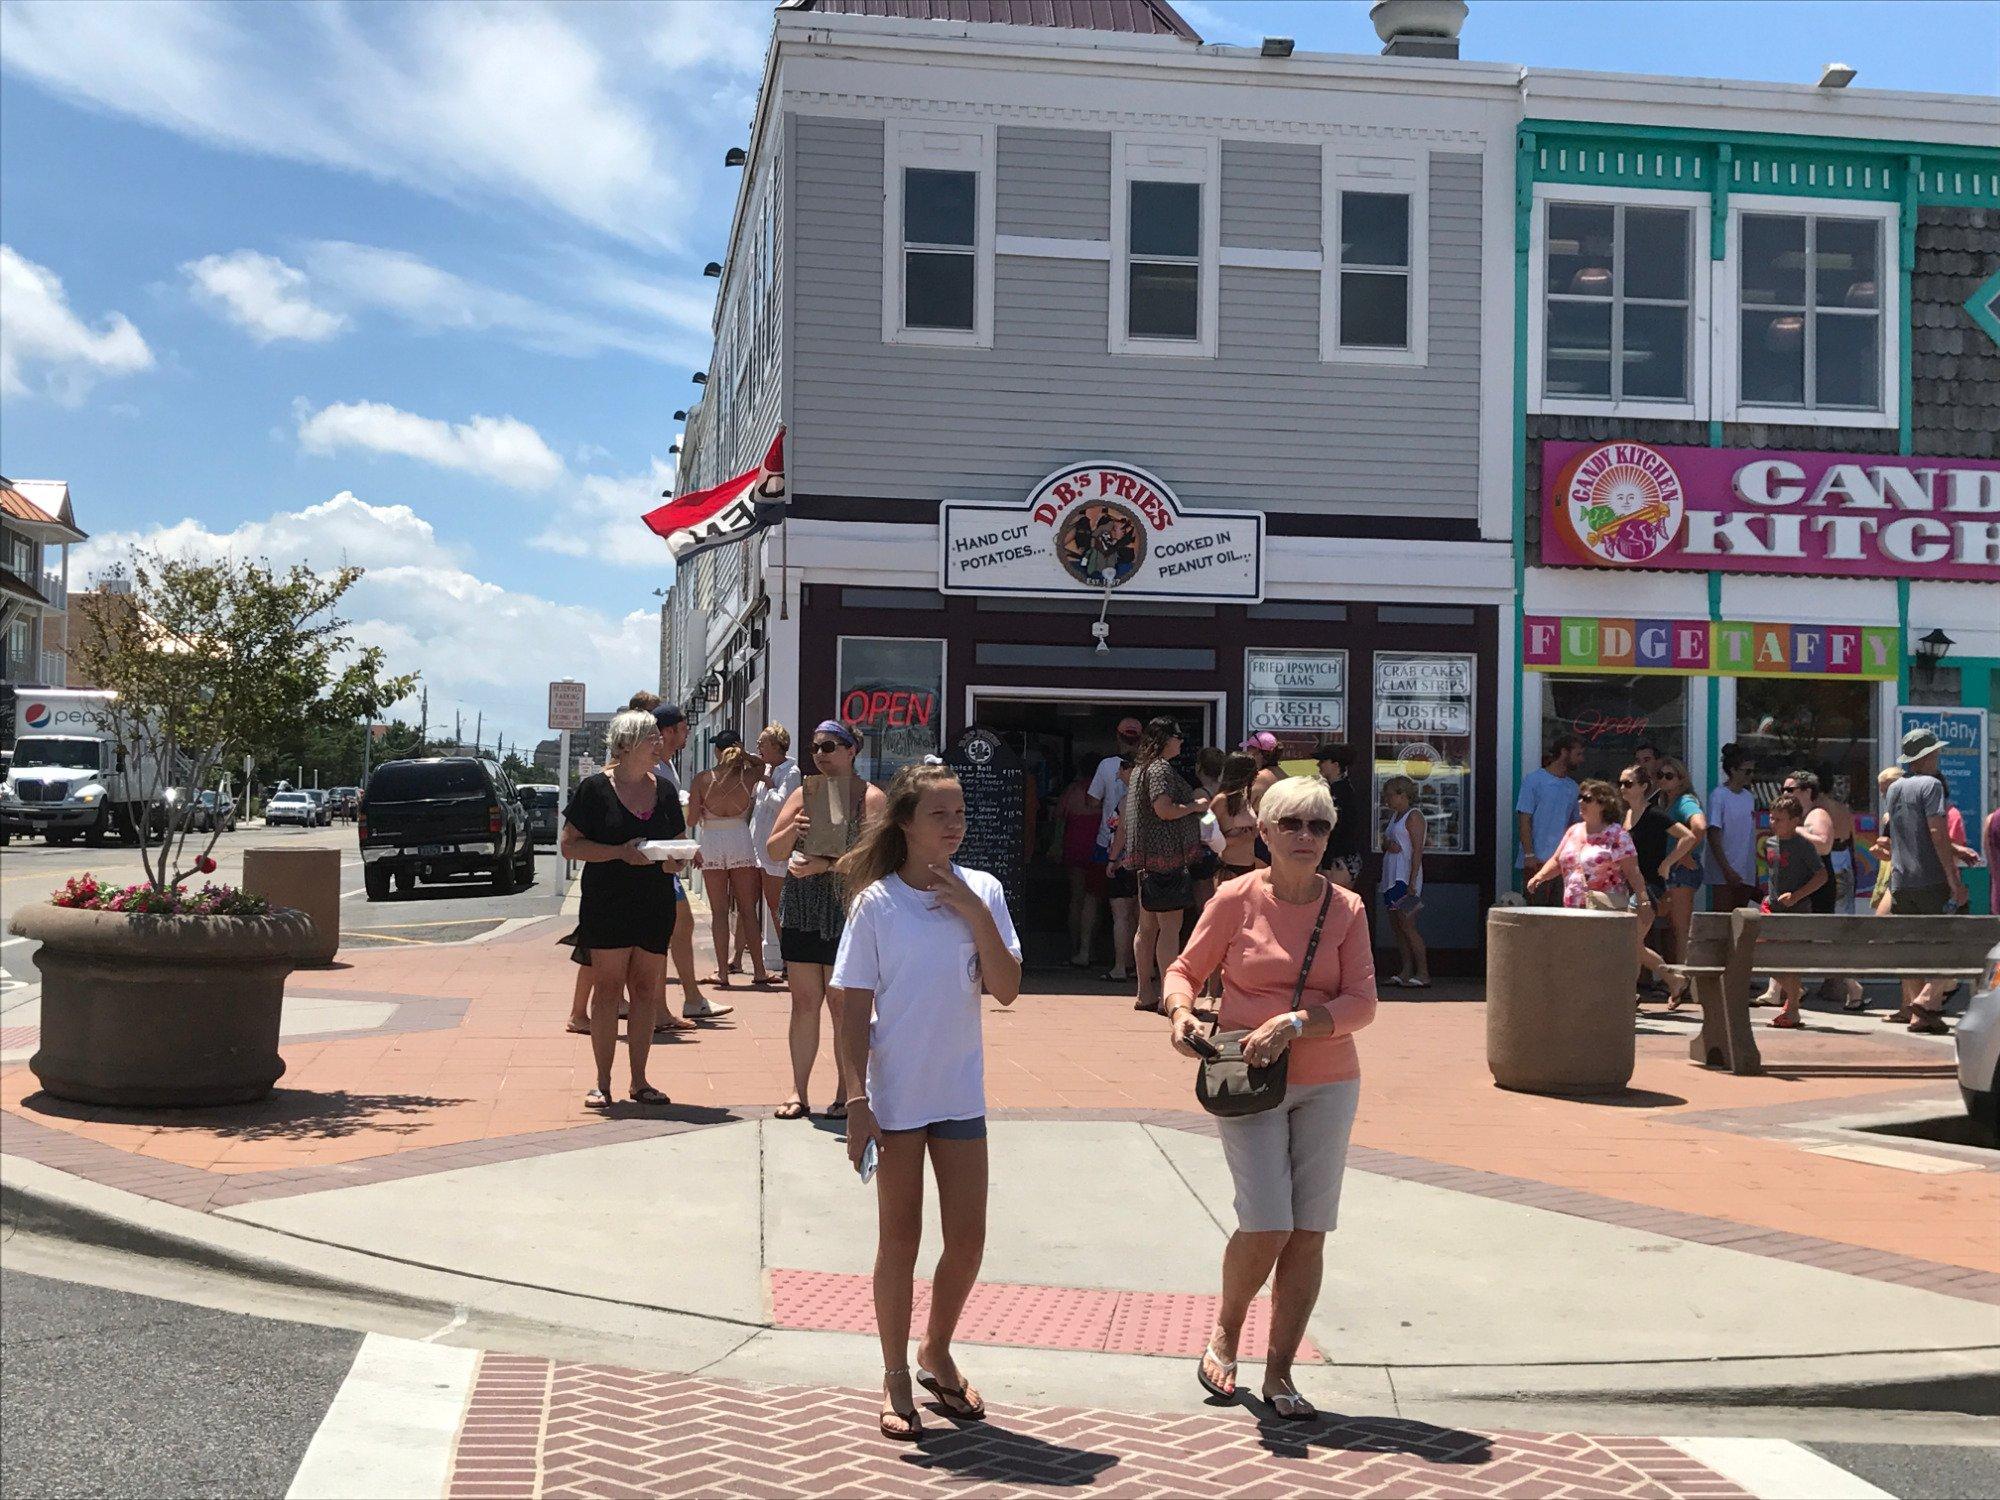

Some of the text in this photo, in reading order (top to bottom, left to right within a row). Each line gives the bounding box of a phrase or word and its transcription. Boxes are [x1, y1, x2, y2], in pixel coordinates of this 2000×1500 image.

[1571, 445, 1680, 503] CANDY KITCHEN
[1098, 471, 1174, 531] FRIES
[955, 525, 1029, 553] HAND CUT
[1154, 531, 1231, 559] COOKED IN
[1159, 555, 1213, 578] PEANUT
[1529, 623, 1704, 661] FUDGE
[1721, 630, 1896, 666] TAFFY
[1253, 661, 1338, 674] FRIED IPSWICH
[1383, 665, 1463, 677] CRAB CAKES
[1274, 674, 1315, 686] CLAMS
[1381, 680, 1466, 691] CLAM STRIPS
[841, 690, 933, 728] OPEN
[1264, 701, 1323, 715] FRESH
[1387, 704, 1459, 719] LOBSTER
[1255, 714, 1332, 728] OYSTERS
[1397, 718, 1448, 731] ROLLS
[1573, 709, 1649, 741] Open
